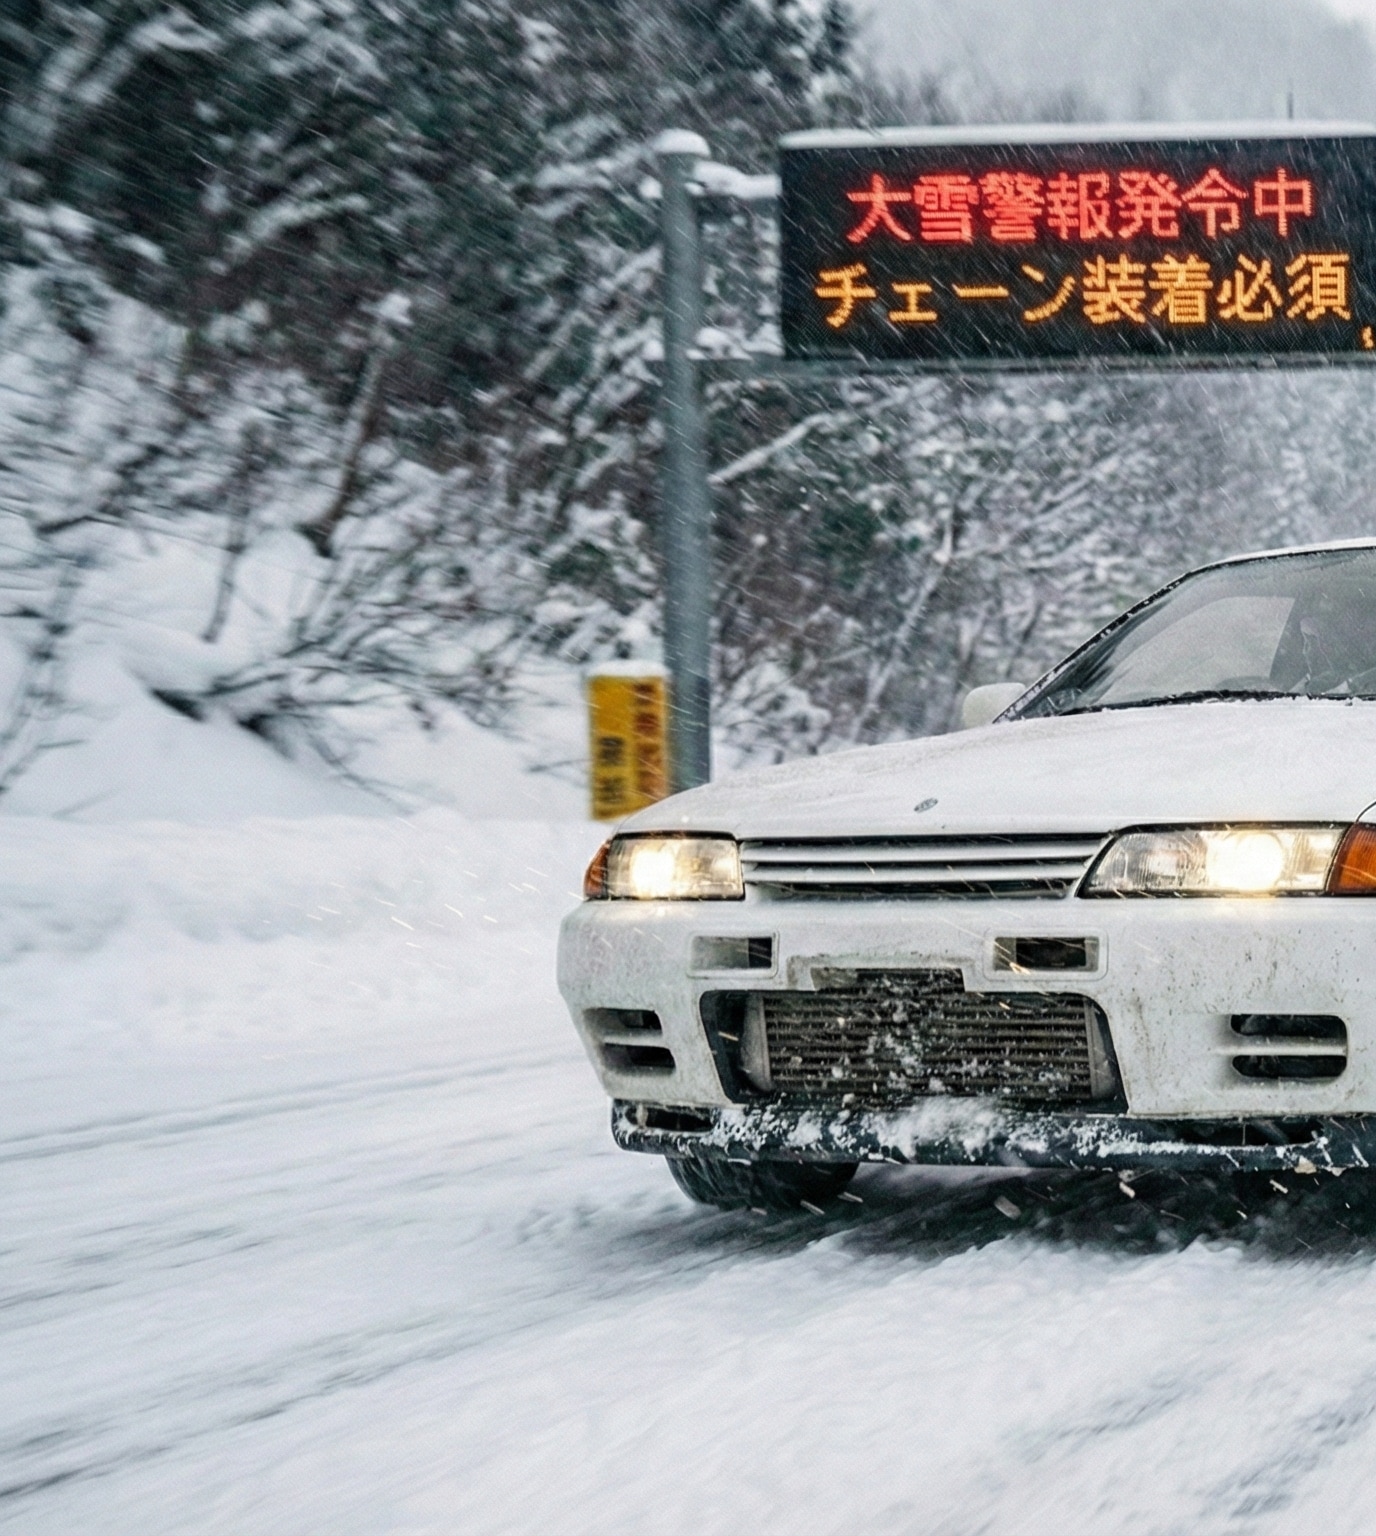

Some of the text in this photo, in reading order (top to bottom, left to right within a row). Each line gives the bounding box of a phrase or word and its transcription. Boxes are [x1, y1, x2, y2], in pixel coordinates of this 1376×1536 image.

[847, 167, 1312, 244] 大雪警報発令中
[815, 253, 1351, 328] チェーン装着必須
